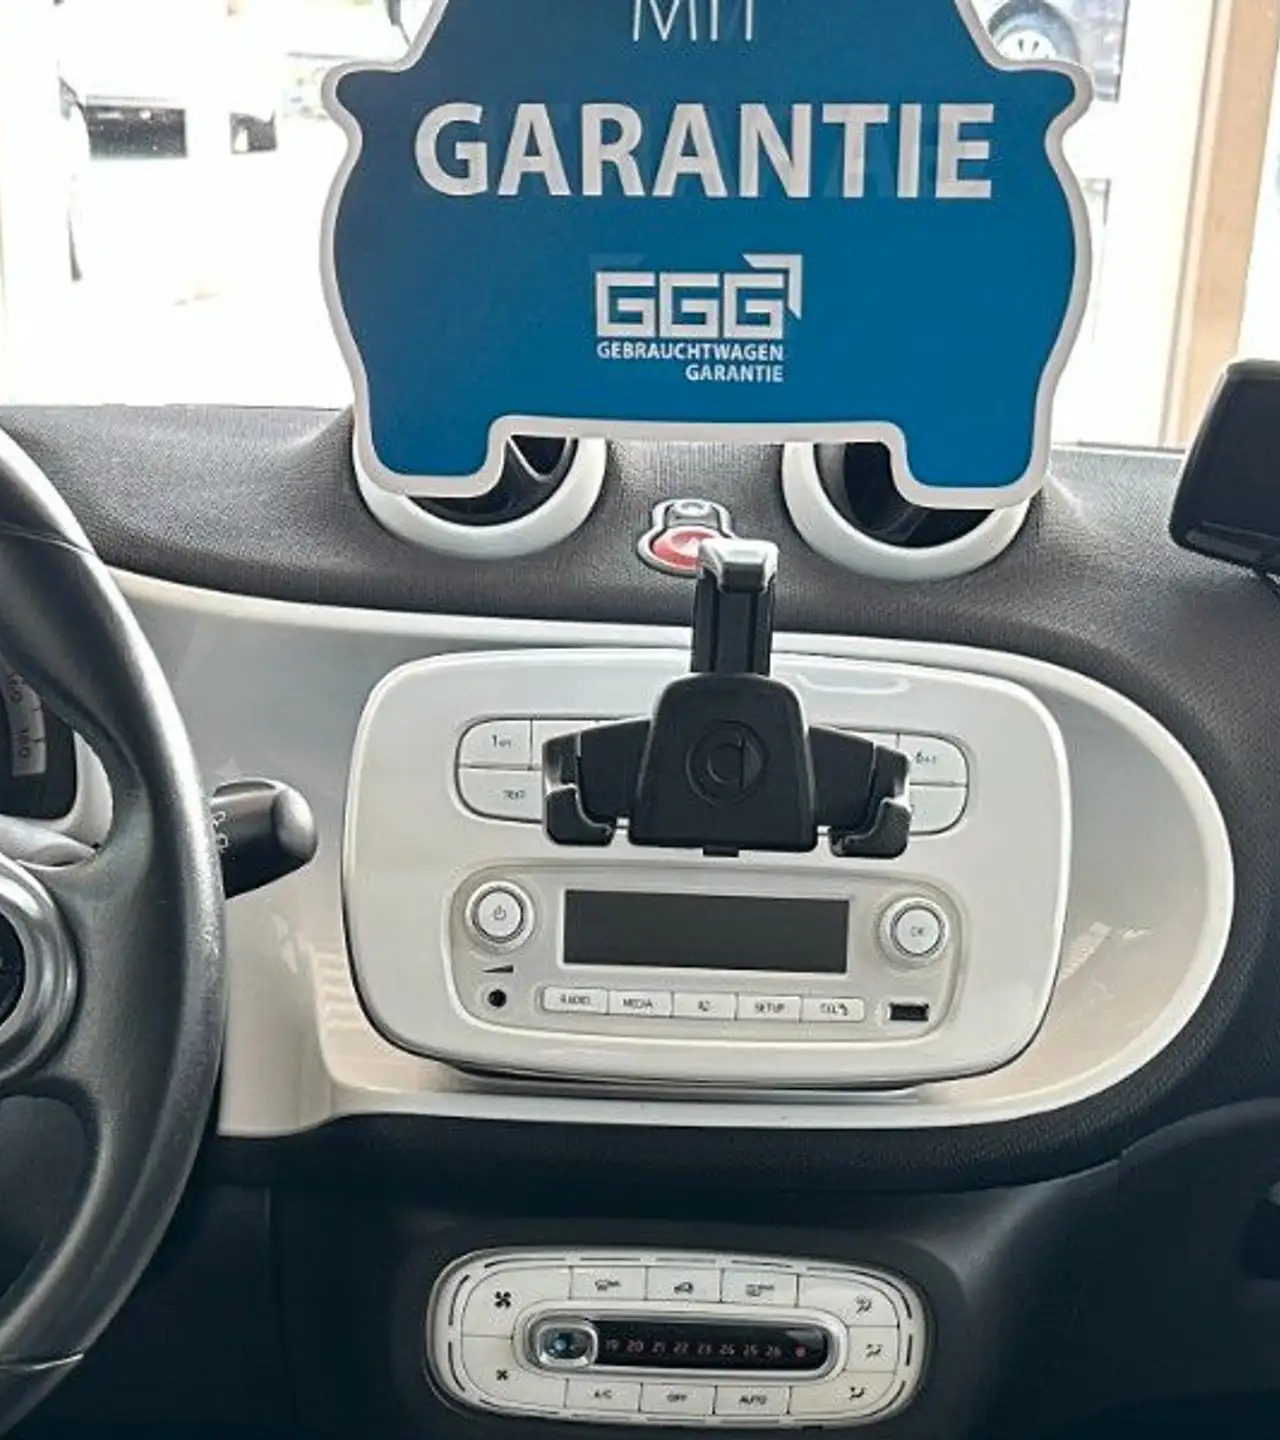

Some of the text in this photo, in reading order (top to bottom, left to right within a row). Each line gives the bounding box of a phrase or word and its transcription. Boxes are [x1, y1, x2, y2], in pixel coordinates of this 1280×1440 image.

[414, 102, 994, 199] GARANTIE
[596, 270, 784, 339] GGG
[597, 341, 784, 361] GEBRAUCHTWAGEN
[685, 364, 784, 383] GARANTIE
[622, 998, 654, 1010] MEDIA
[755, 1002, 788, 1014] SETUP
